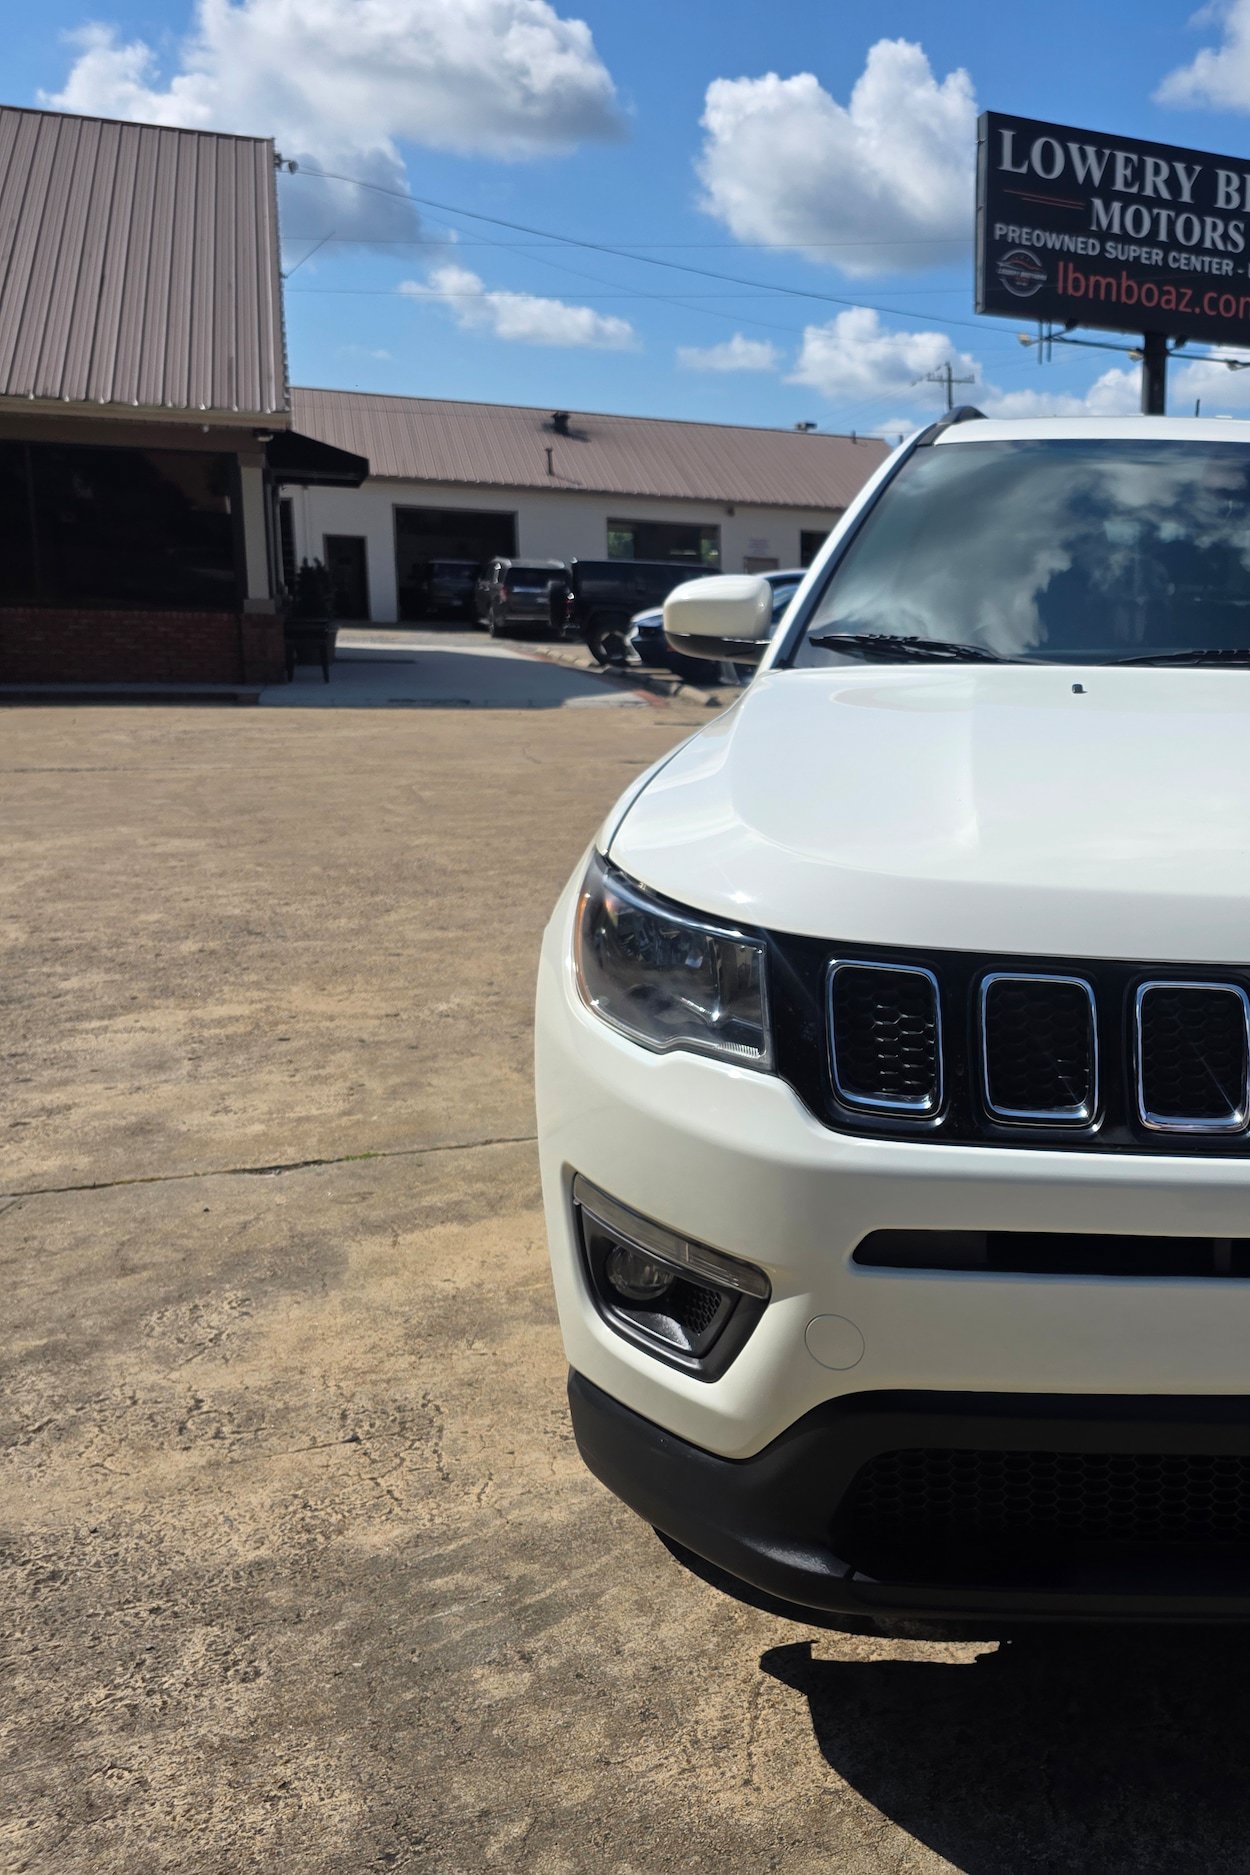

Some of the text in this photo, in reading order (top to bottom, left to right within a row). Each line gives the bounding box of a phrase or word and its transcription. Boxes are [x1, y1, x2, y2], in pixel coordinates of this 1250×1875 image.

[997, 129, 1203, 205] LOWERY
[994, 223, 1100, 256] PREOWNED
[1105, 240, 1163, 266] SUPER
[1167, 251, 1234, 277] CENTER
[1090, 197, 1246, 254] MOTORS
